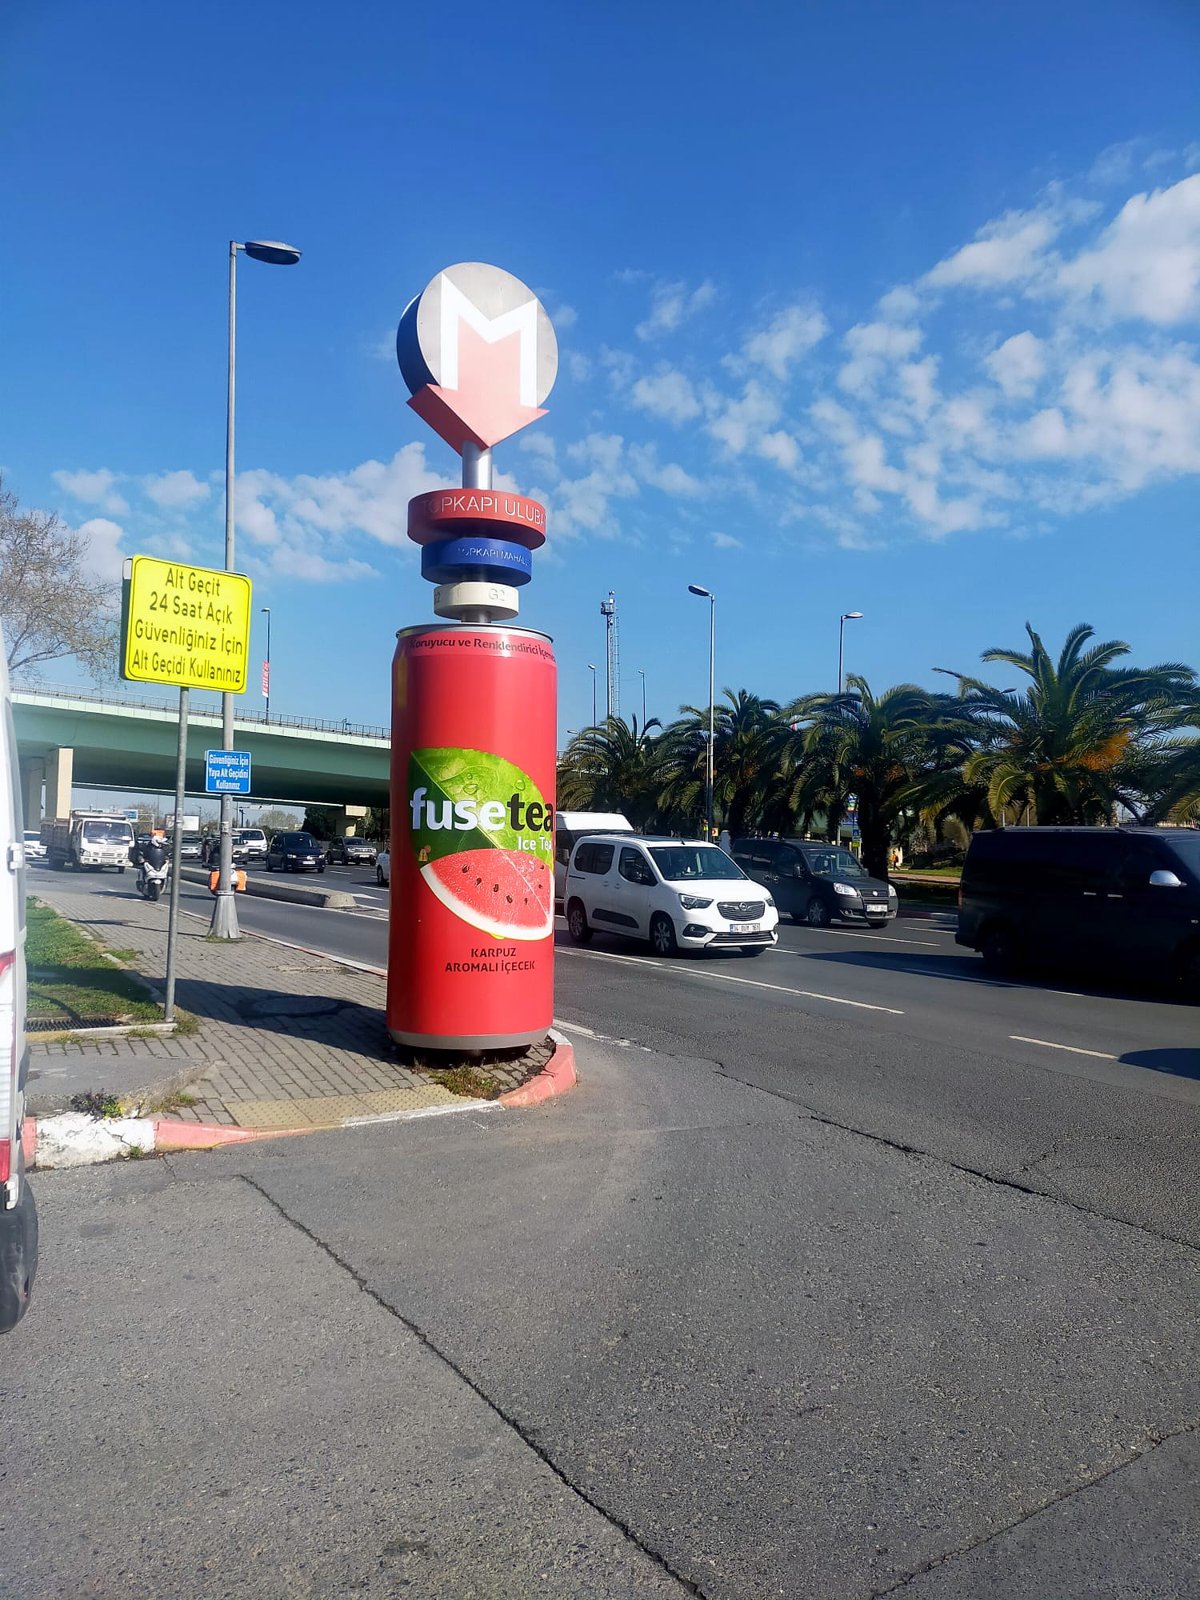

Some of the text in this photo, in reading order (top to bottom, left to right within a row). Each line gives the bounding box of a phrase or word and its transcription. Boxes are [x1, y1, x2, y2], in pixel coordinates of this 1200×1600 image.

[441, 272, 537, 408] M
[457, 546, 499, 558] OPKAPI
[165, 568, 221, 597] Alt Geçit
[149, 591, 233, 625] 24 Saat Açık
[135, 619, 243, 655] Güvenliğiniz İçin
[410, 638, 455, 650] Koruyucu
[458, 639, 471, 647] ve
[473, 638, 538, 654] Renklendirici
[132, 649, 149, 670] Alt
[152, 652, 186, 677] Geçidi
[189, 657, 241, 683] Kullanınız
[518, 836, 536, 850] Ice
[471, 947, 517, 958] KARPUZ
[445, 960, 535, 974] AROMALI İÇECEK
